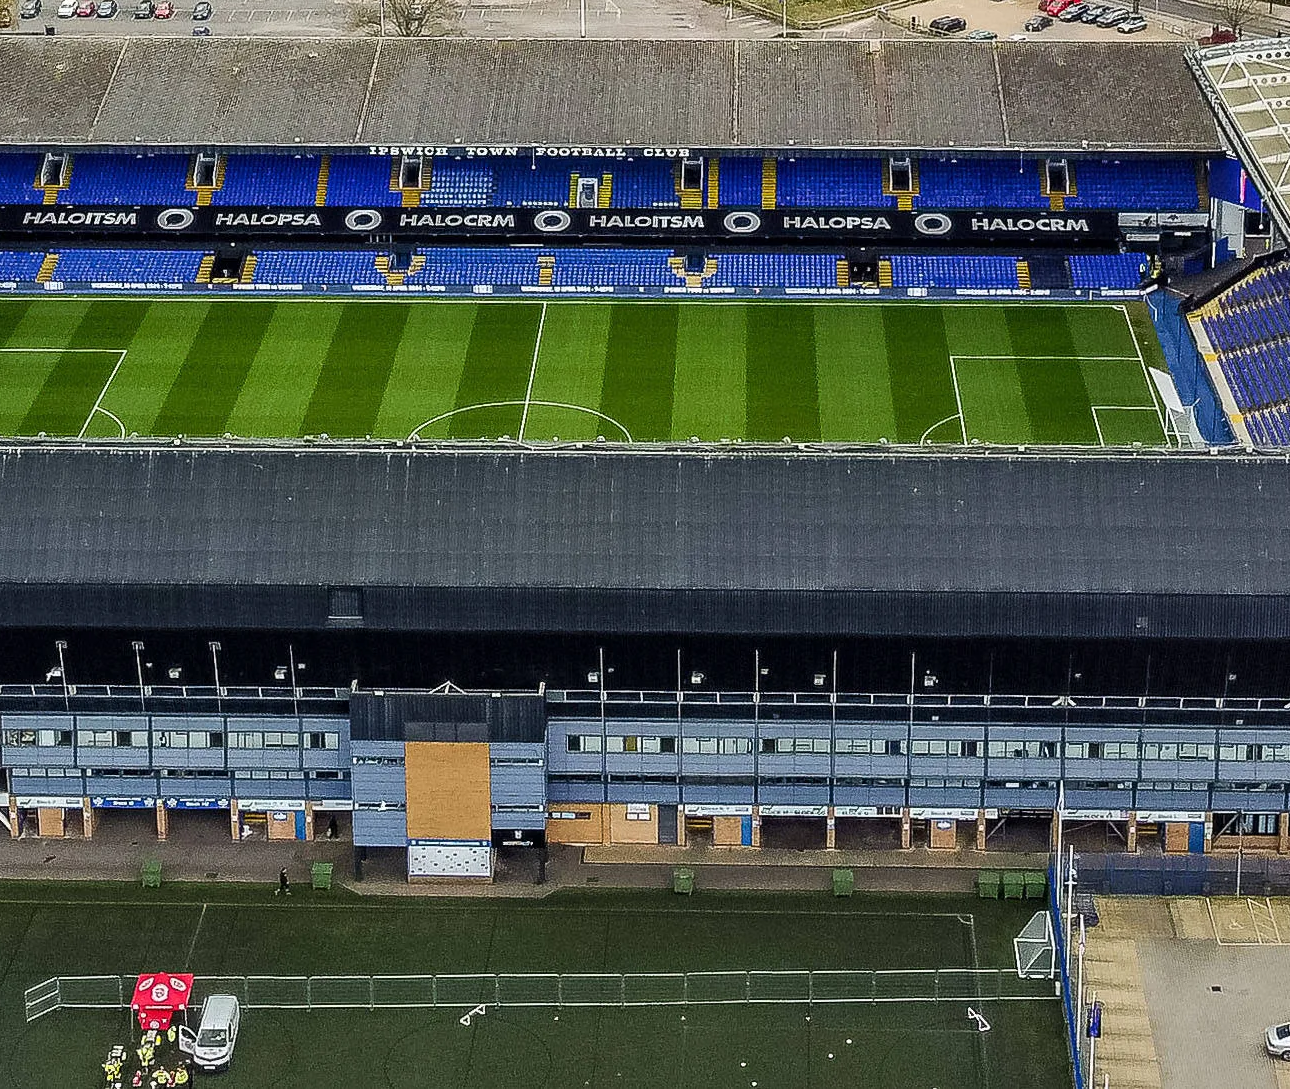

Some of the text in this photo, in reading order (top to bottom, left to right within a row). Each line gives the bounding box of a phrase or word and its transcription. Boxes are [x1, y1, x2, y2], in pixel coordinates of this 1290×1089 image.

[369, 146, 690, 158] IPSWICH TOWN FOOTBALL CLUB
[23, 212, 137, 226] HALOITSM
[214, 212, 322, 226] HALOPSA
[400, 213, 515, 228] HALOCRM
[589, 215, 705, 229] HALOITSM
[783, 216, 891, 230] HALOPSA
[970, 217, 1089, 232] HALOCRM
